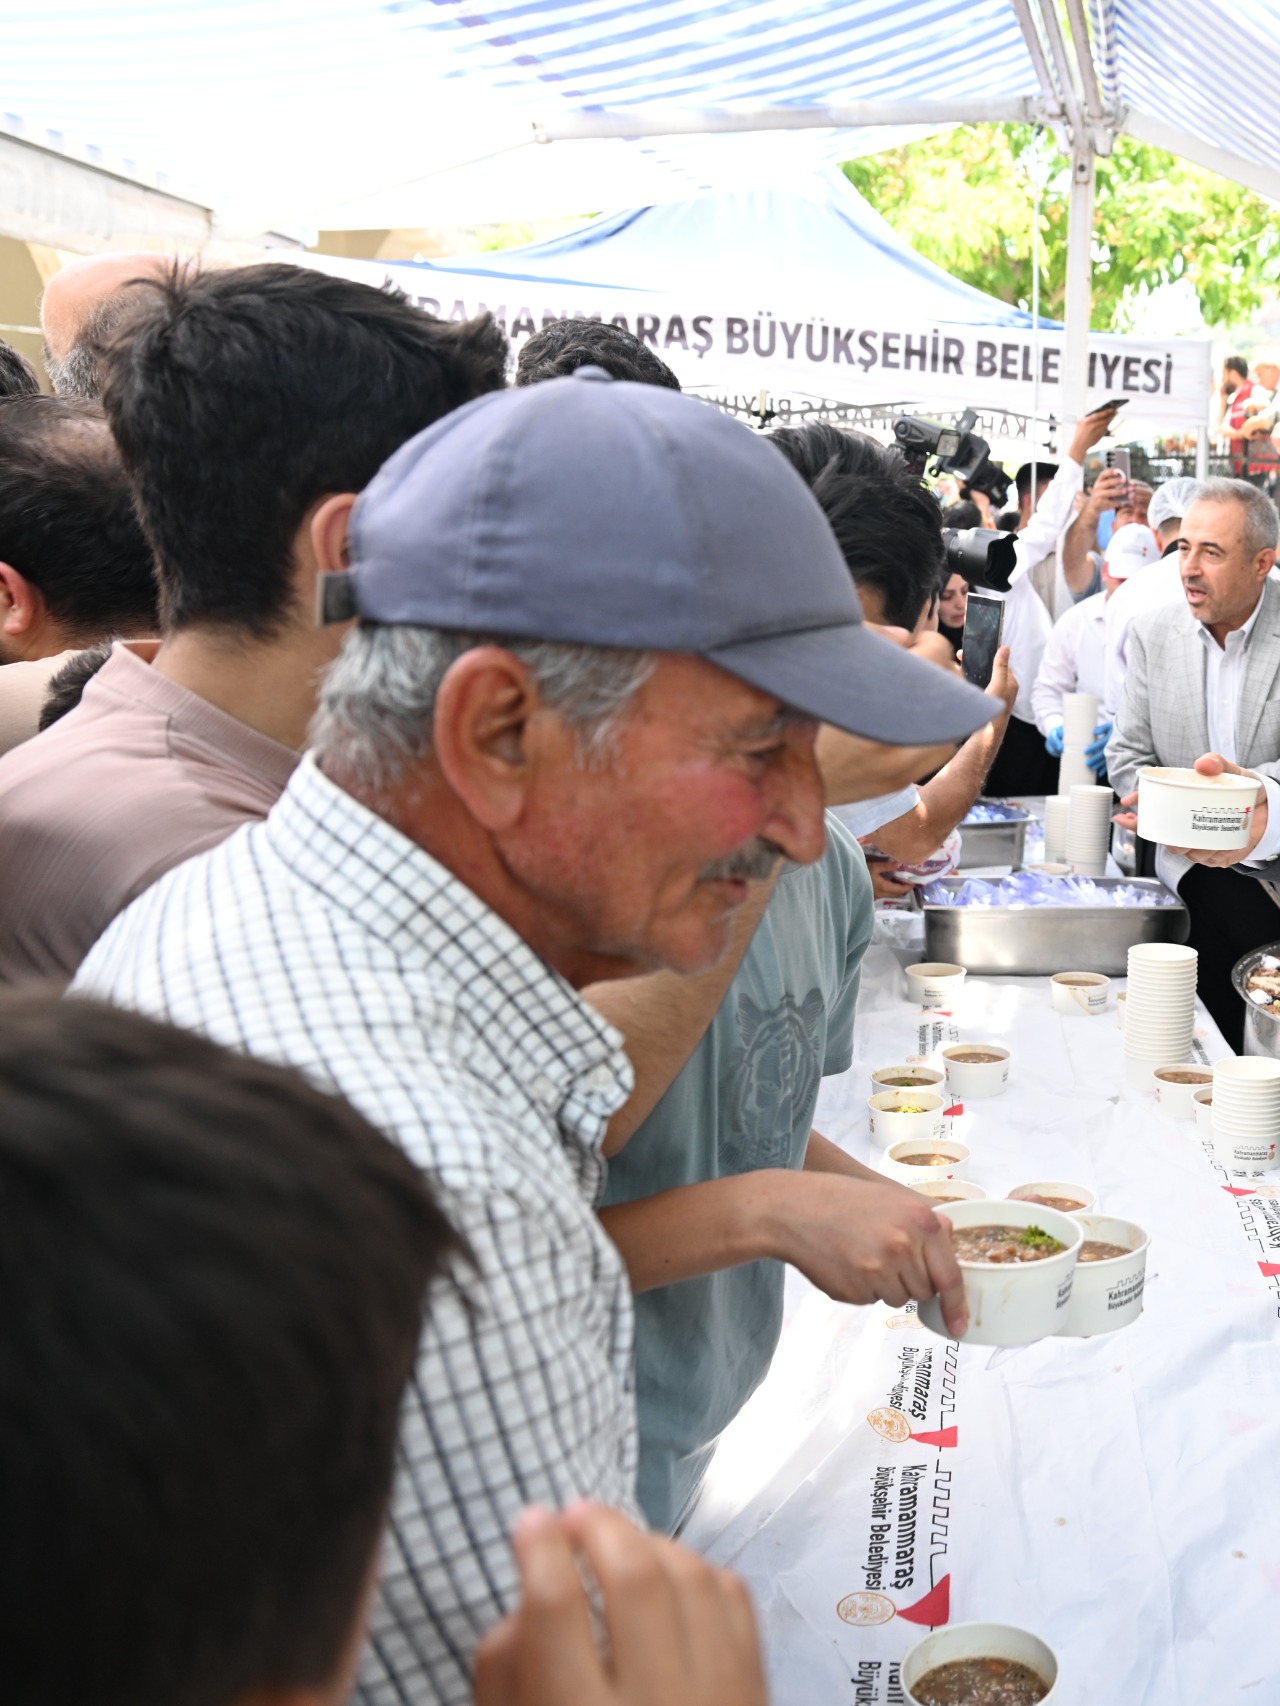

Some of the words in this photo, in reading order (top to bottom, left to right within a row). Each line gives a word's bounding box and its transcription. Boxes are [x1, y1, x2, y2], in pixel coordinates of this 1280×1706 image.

[726, 310, 965, 376] BÜYÜKŞEHİR
[870, 1466, 897, 1521] Büyükşehir
[889, 1463, 928, 1590] Kahramanmaraş
[861, 1523, 892, 1591] Belediyesi
